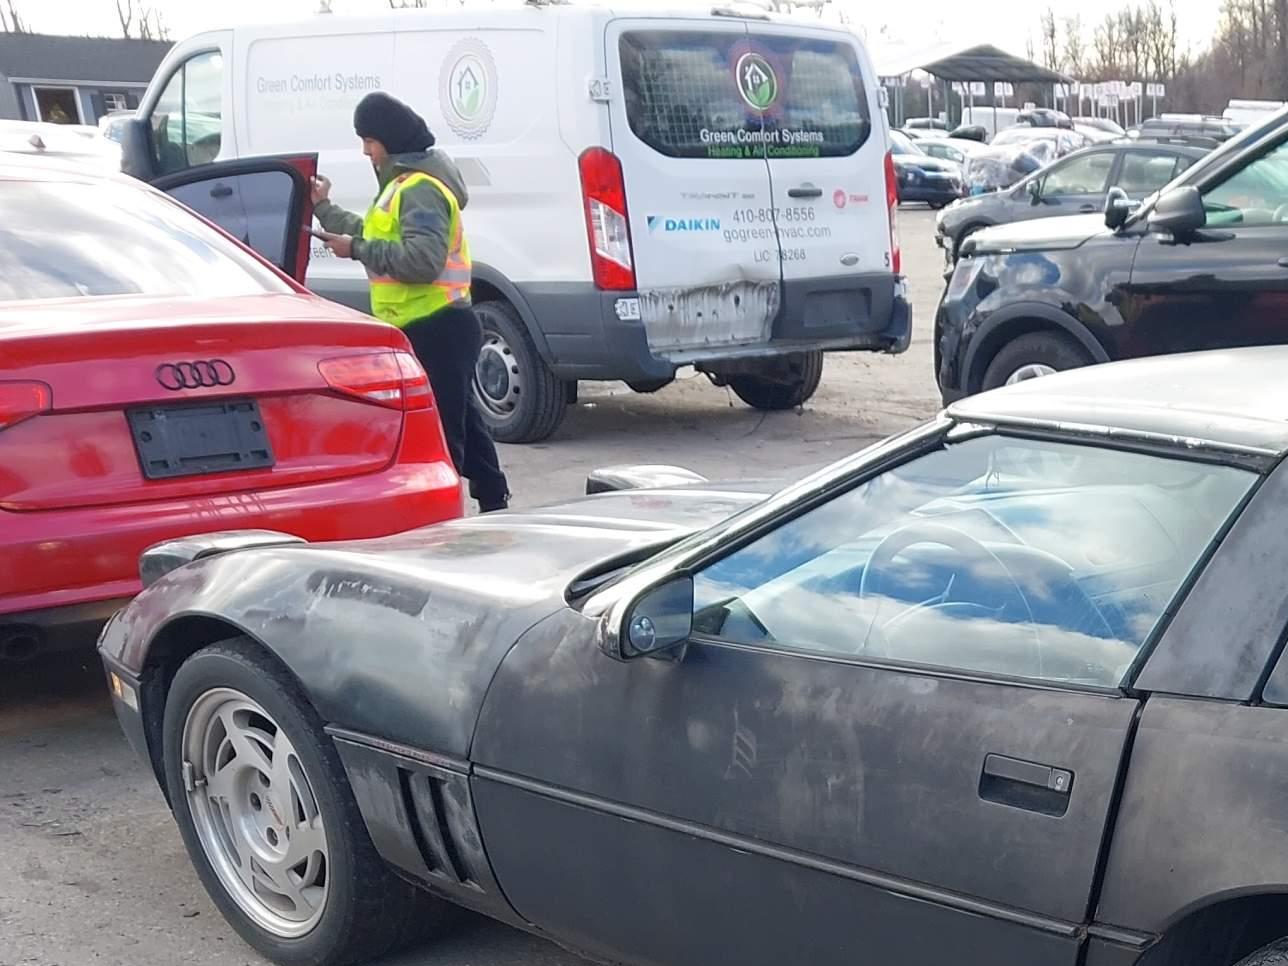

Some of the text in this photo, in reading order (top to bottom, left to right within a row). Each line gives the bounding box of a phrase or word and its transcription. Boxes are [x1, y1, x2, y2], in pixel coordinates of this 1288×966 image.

[256, 72, 381, 93] Green Comfort Systems
[700, 128, 824, 144] Green Comfort Systems
[707, 144, 743, 158] Heating
[744, 145, 752, 157] &
[767, 144, 819, 157] Conditioning
[732, 206, 815, 223] 410-807-8556
[665, 218, 721, 232] DAIKIN
[723, 225, 832, 243] gogreen-hvac.com
[753, 249, 770, 263] LIC
